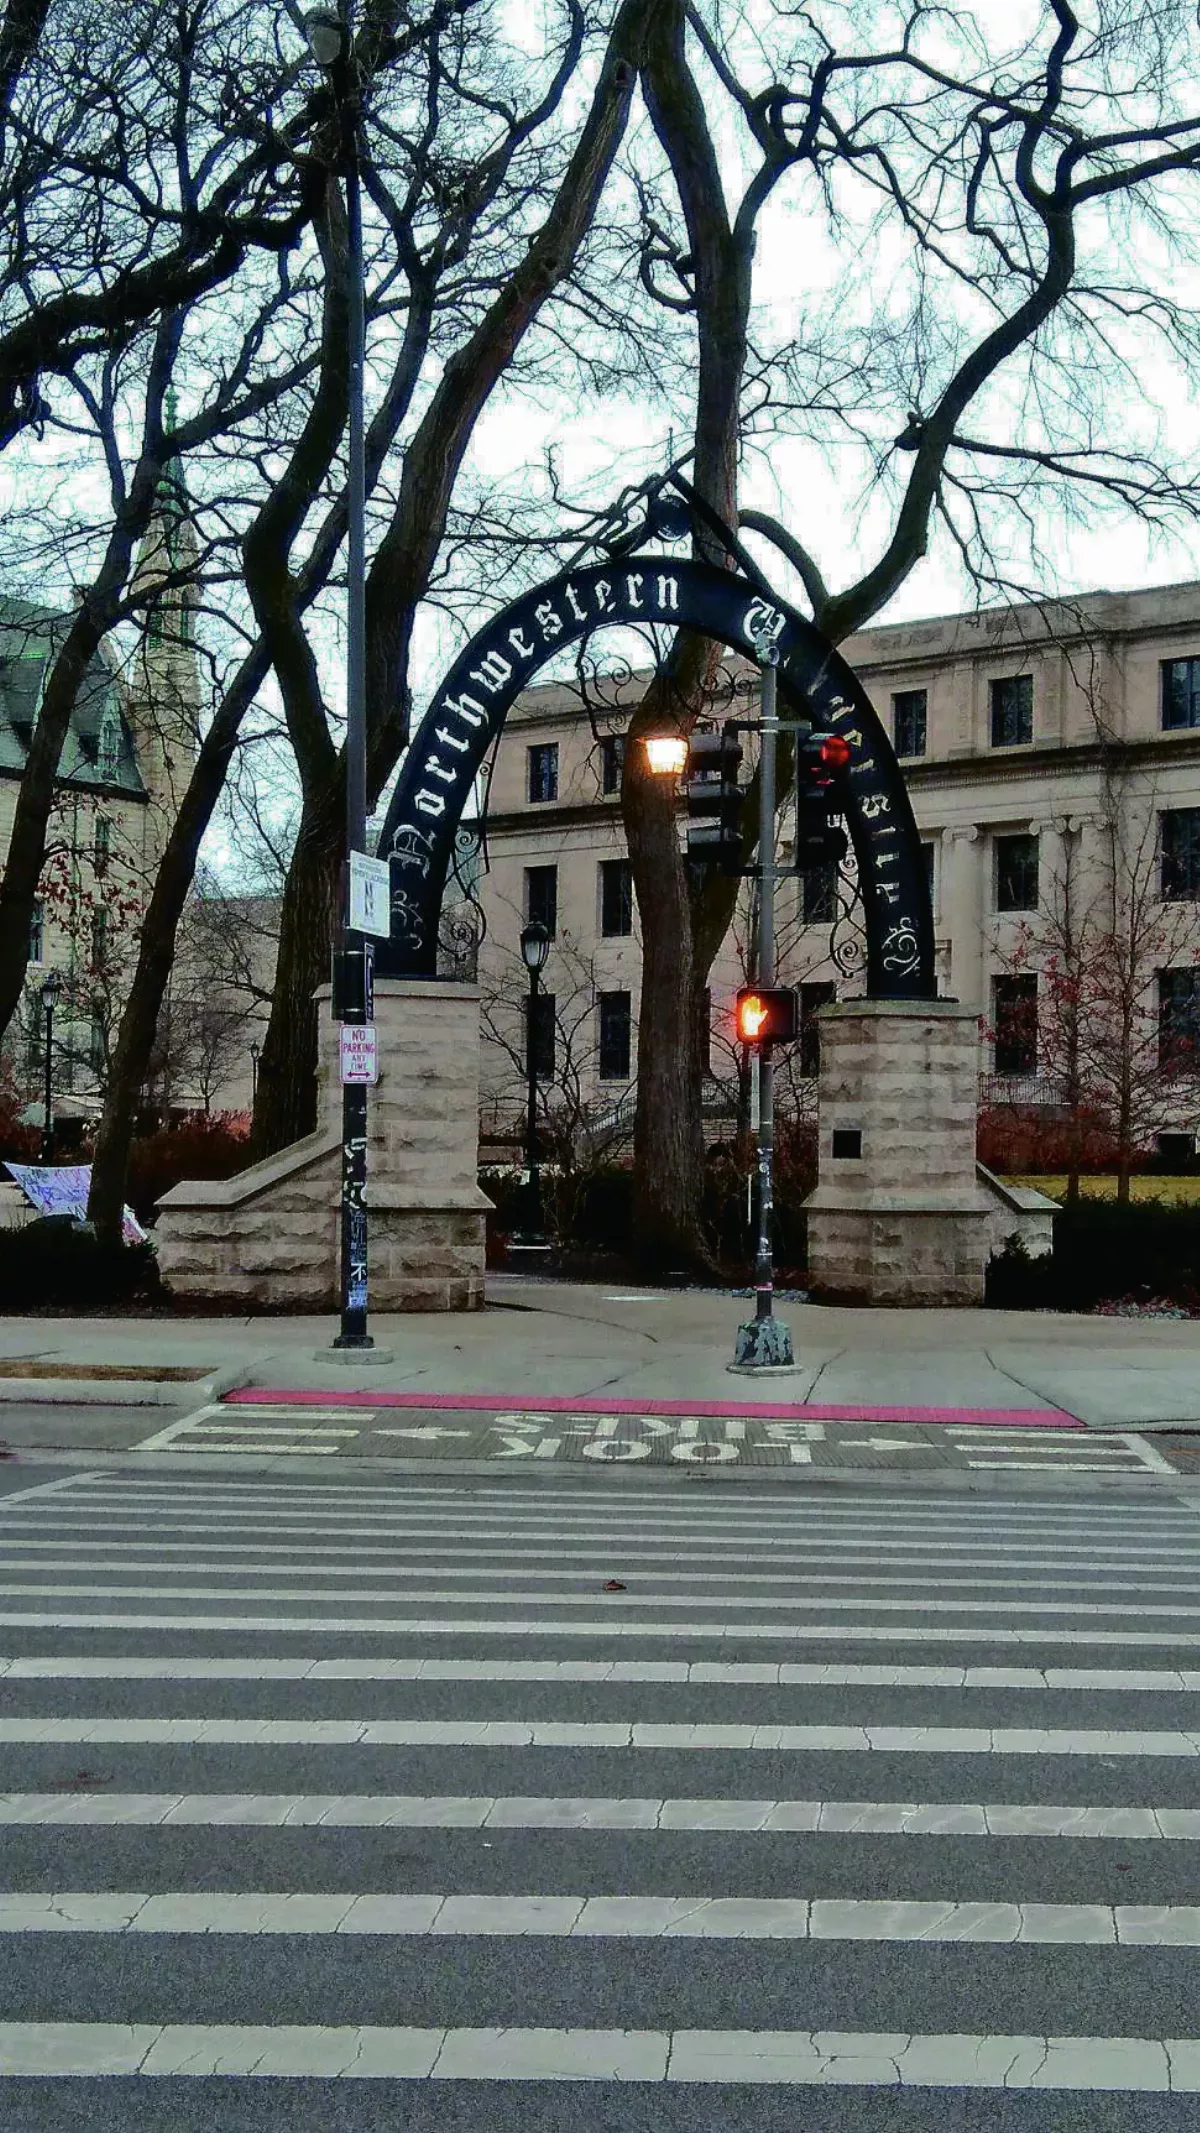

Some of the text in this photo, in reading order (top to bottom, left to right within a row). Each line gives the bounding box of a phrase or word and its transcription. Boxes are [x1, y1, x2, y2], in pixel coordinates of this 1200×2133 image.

[388, 572, 900, 904] Northwestern Uiversity
[342, 1043, 376, 1053] PARKING
[351, 1029, 366, 1042] NO
[488, 1415, 827, 1441] BIKES
[490, 1436, 812, 1463] LOOK
